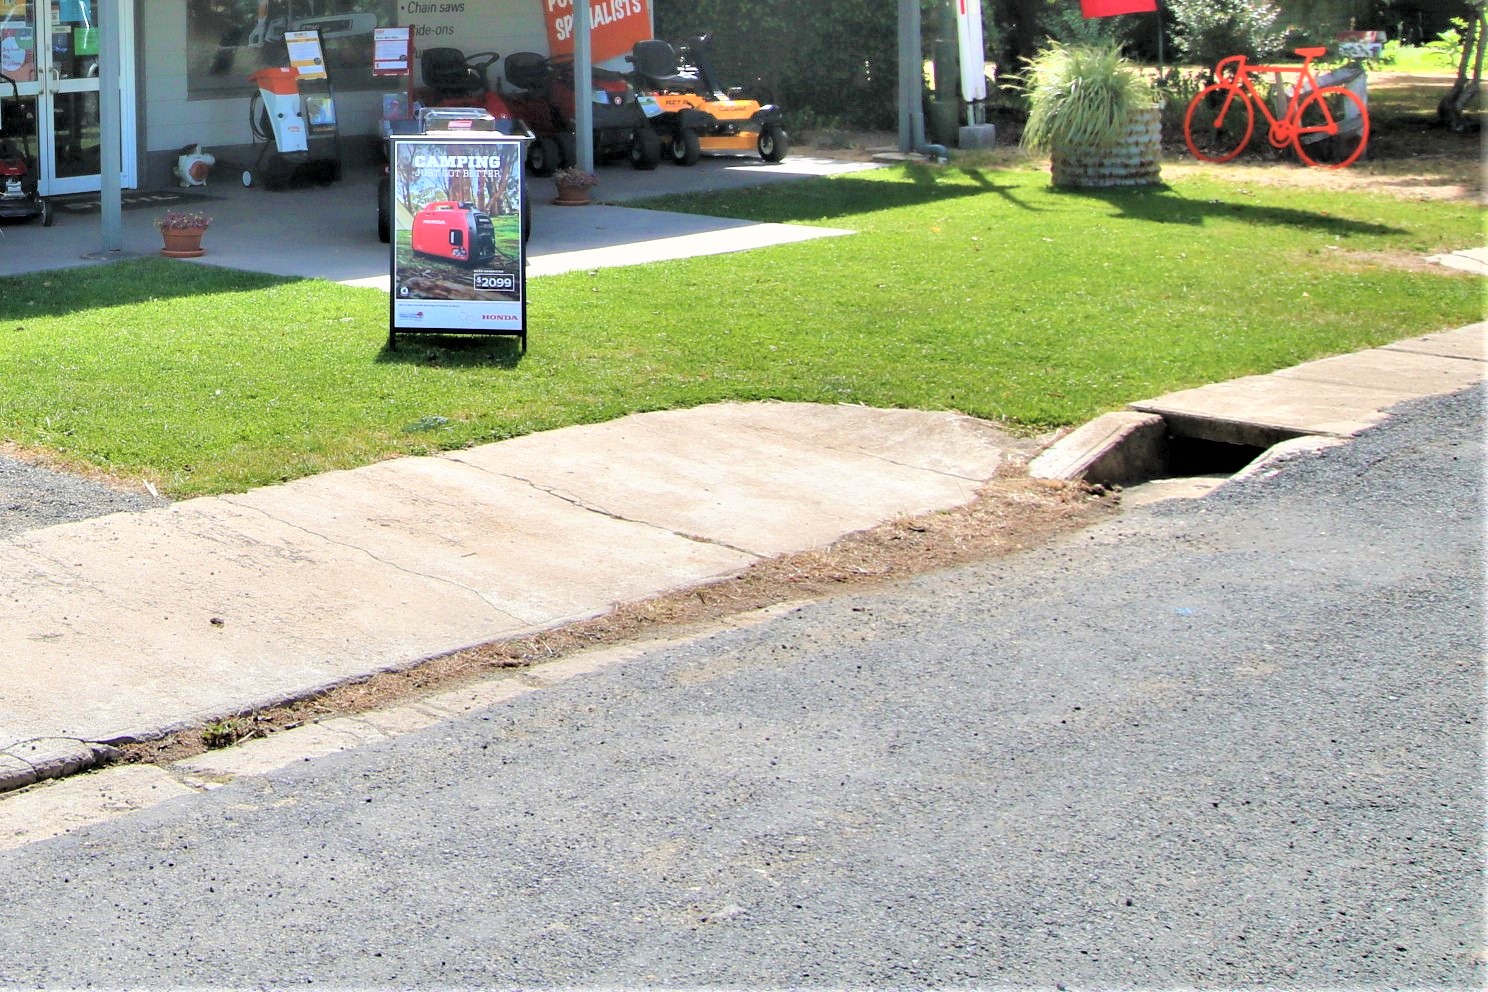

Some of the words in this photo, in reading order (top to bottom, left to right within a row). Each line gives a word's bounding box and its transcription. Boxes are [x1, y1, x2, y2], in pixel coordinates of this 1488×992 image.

[407, 1, 437, 14] Chain
[439, 2, 465, 13] saws
[414, 24, 455, 36] ide-ons
[414, 155, 501, 169] CAMPING
[414, 169, 442, 178] JUST
[443, 169, 463, 178] GOT
[463, 169, 501, 178] BETTER
[476, 275, 512, 288] $2099
